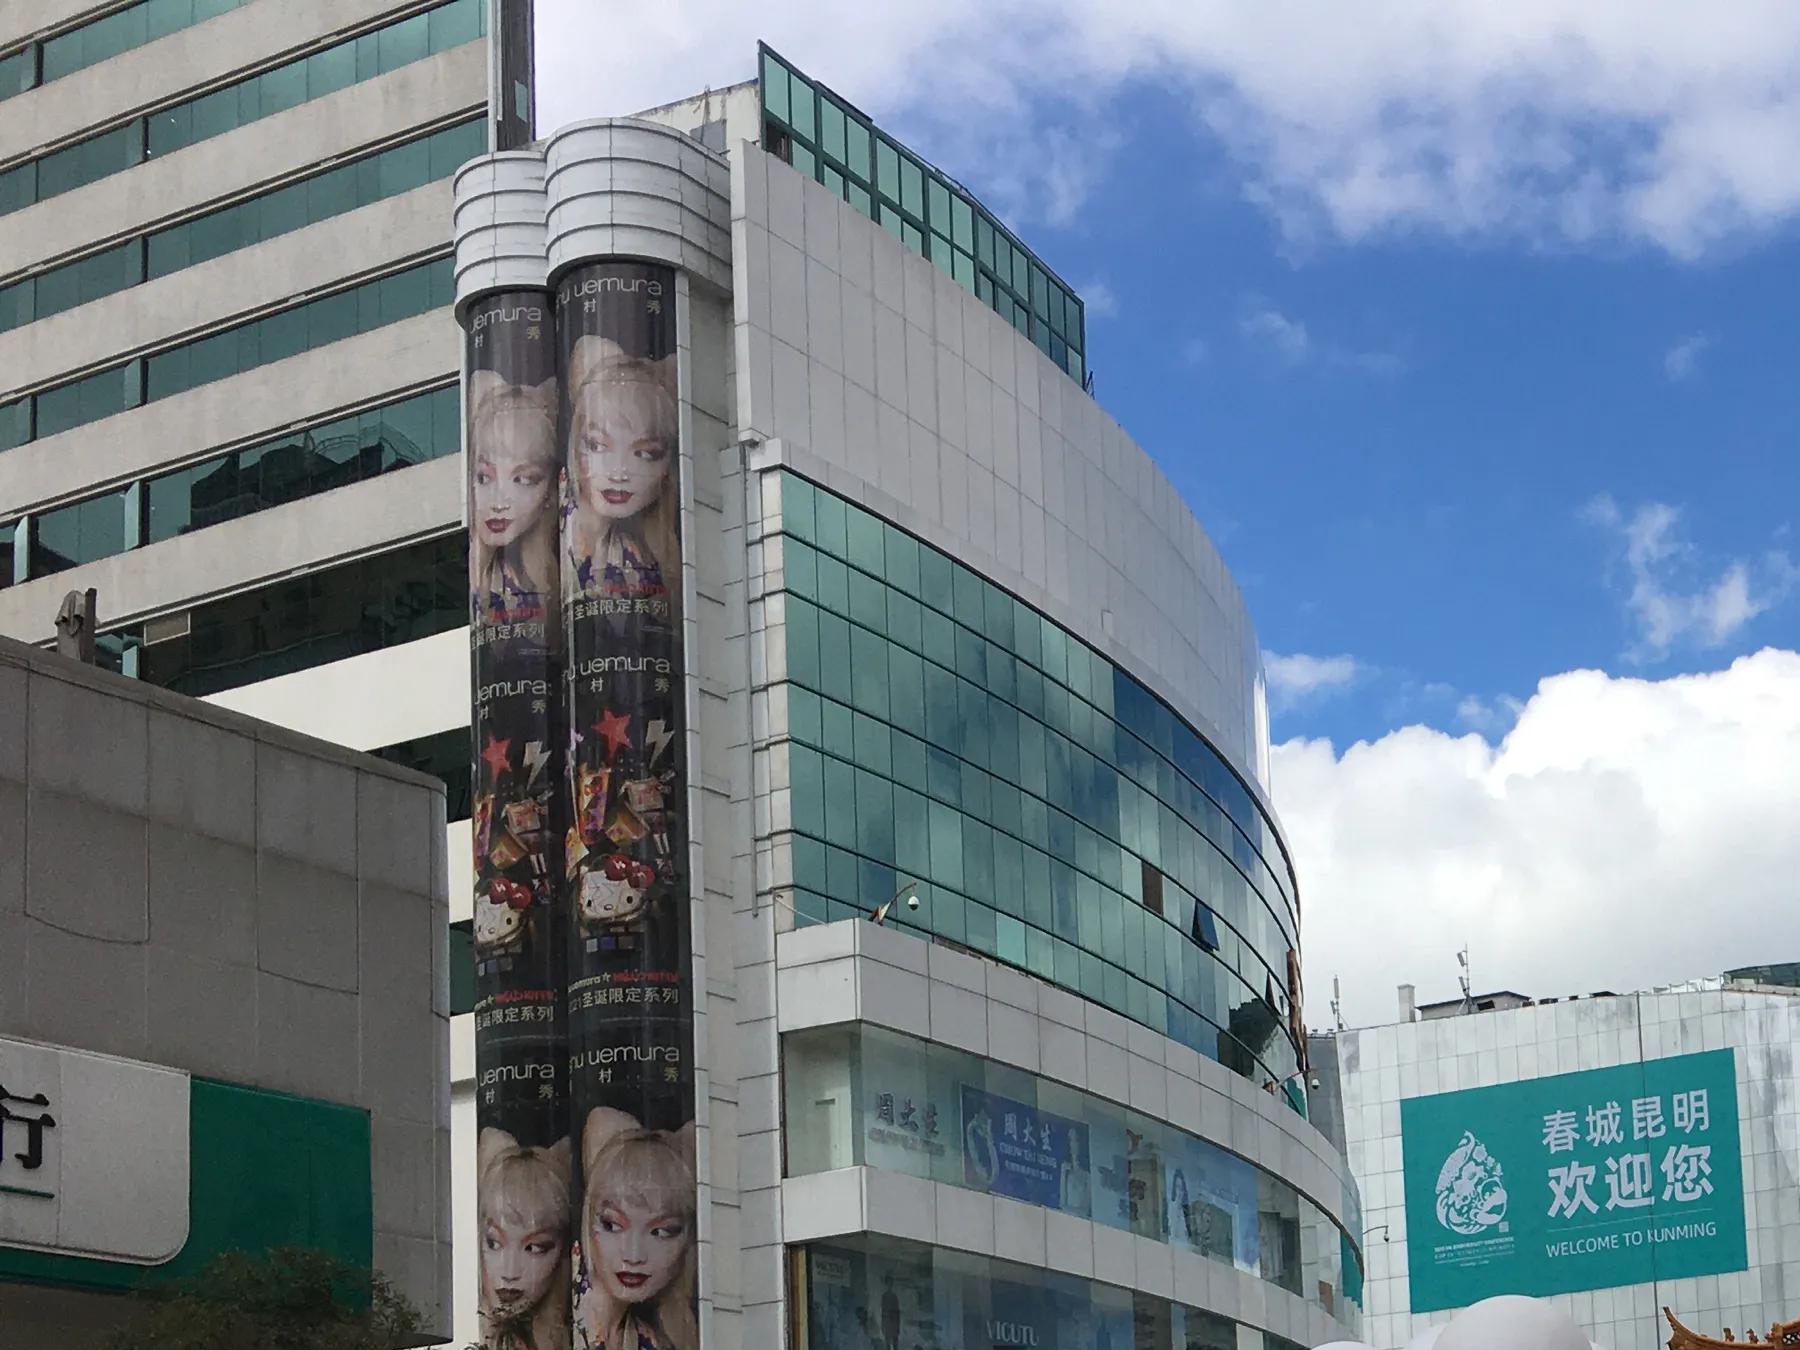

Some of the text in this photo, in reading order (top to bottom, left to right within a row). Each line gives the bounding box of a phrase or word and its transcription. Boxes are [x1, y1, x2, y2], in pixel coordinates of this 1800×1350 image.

[574, 277, 662, 297] uemura
[580, 656, 670, 676] uemura
[591, 677, 604, 692] 村
[588, 1046, 680, 1066] uemura
[599, 1066, 678, 1084] 村 秀
[485, 1084, 553, 1104] 村 秀
[1542, 1089, 1710, 1154] 春城昆明
[1004, 1113, 1053, 1151] 周大生
[1547, 1144, 1715, 1219] 欢迎您
[1546, 1222, 1717, 1257] WELCOME TO KUNMING
